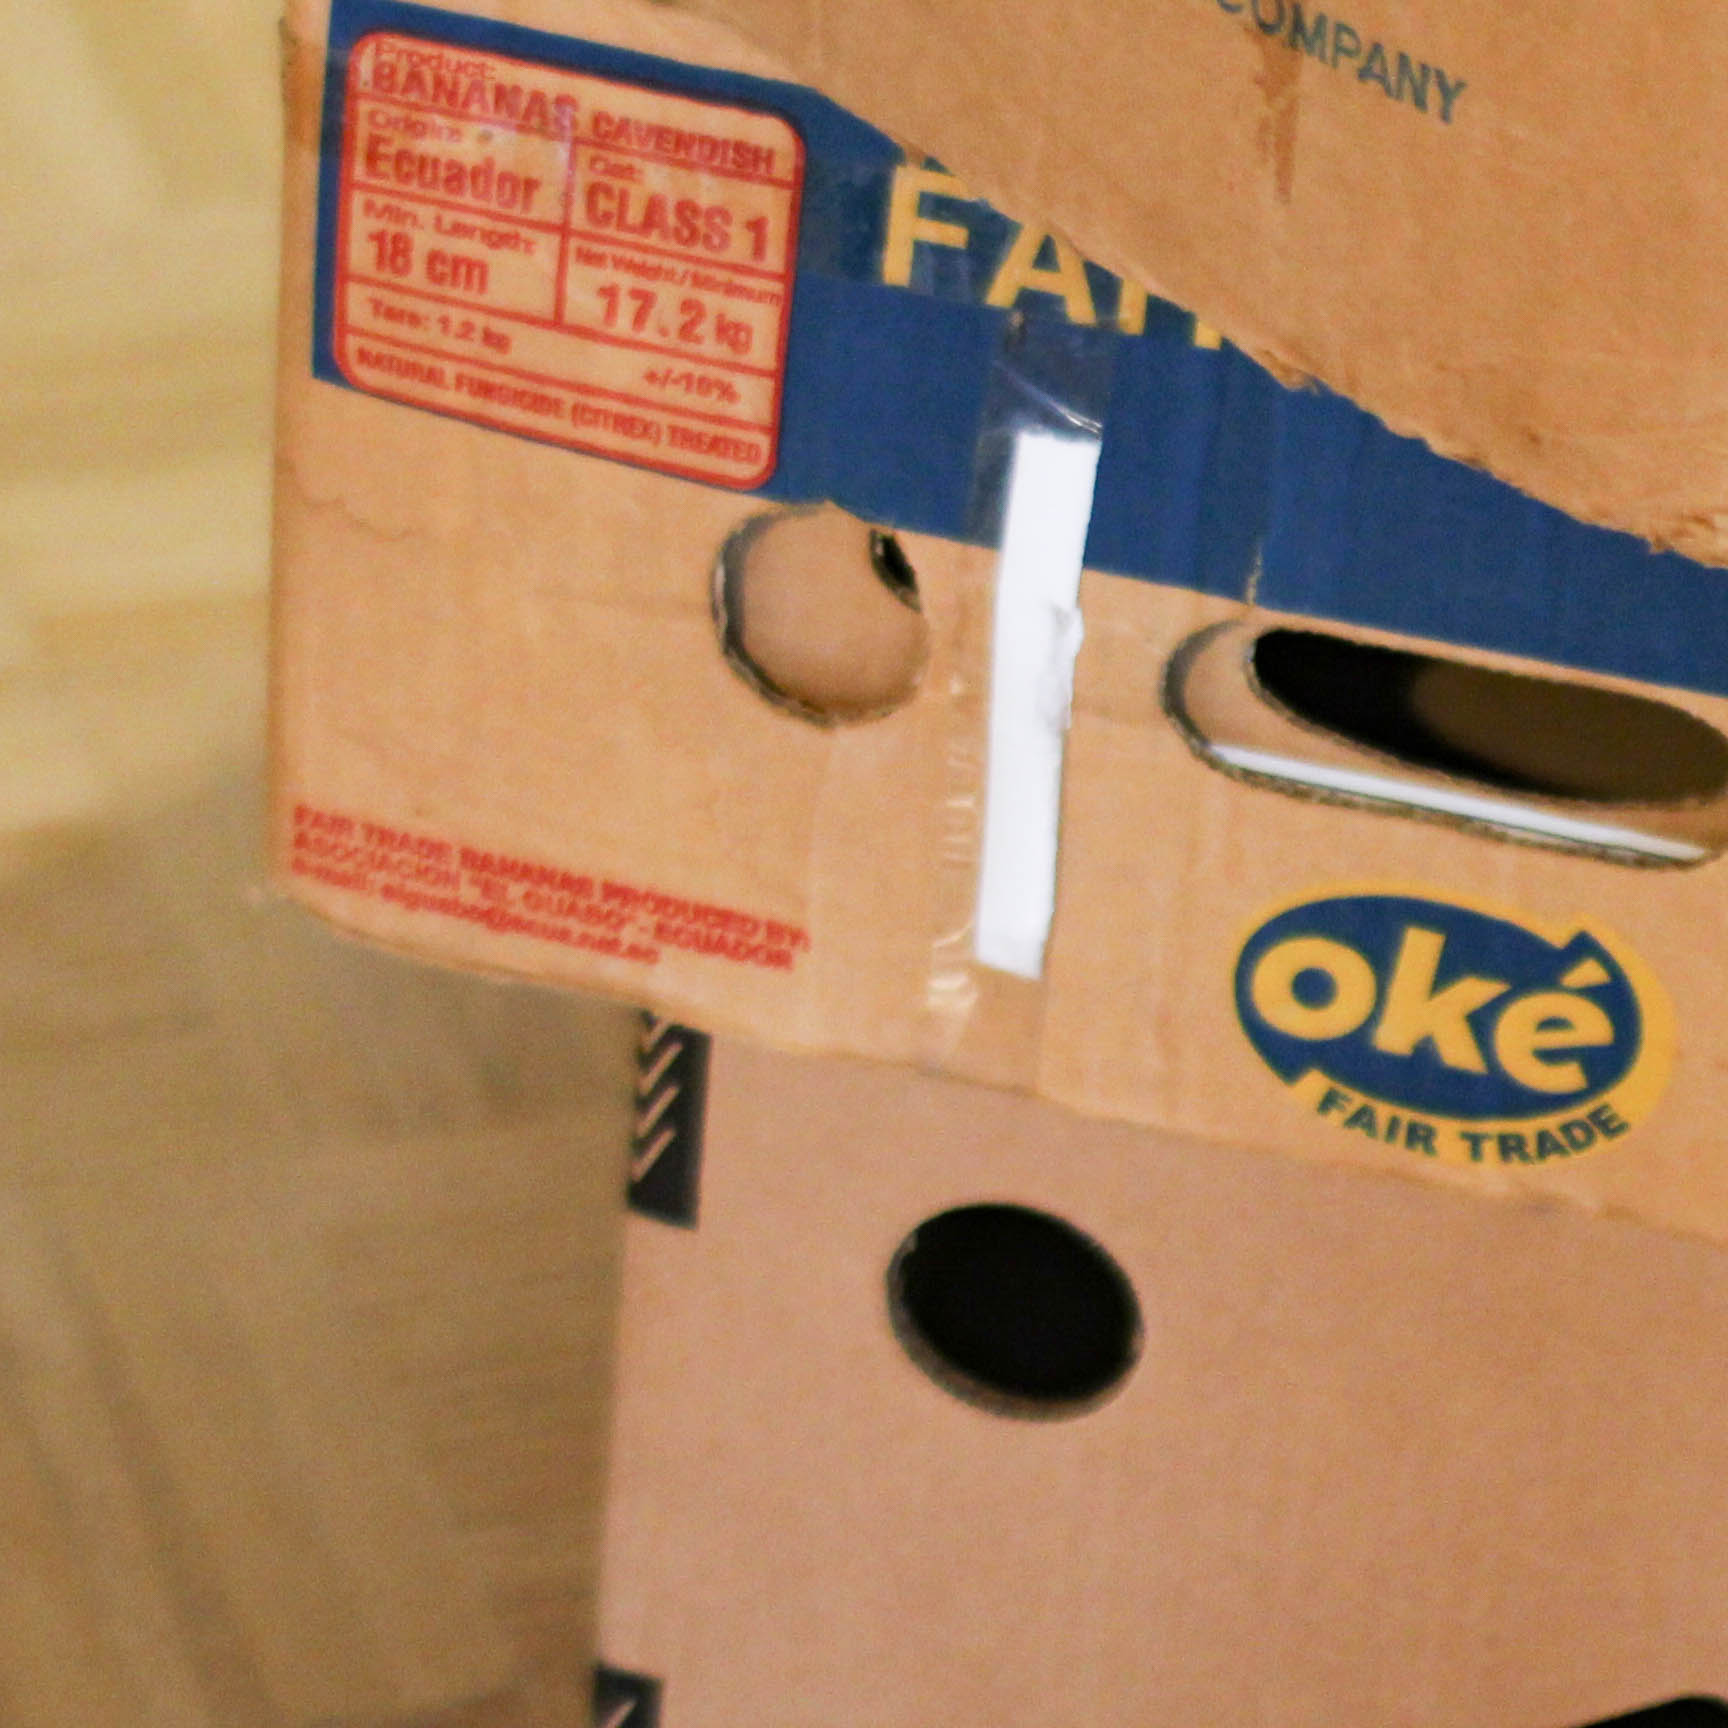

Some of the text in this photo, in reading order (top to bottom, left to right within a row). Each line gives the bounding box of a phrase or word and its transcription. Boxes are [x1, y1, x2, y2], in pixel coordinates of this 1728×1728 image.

[373, 62, 775, 172] BANANAS CAVENDISH
[366, 133, 541, 214] Ecuador
[368, 229, 489, 295] 18 cm
[585, 181, 769, 262] CLASS 1
[597, 283, 753, 355] 17.2 kg
[356, 347, 450, 390] NATURAL
[667, 425, 762, 465] TREATED
[1251, 924, 1615, 1095] oké
[1316, 1086, 1632, 1165] FAIR TRADE
